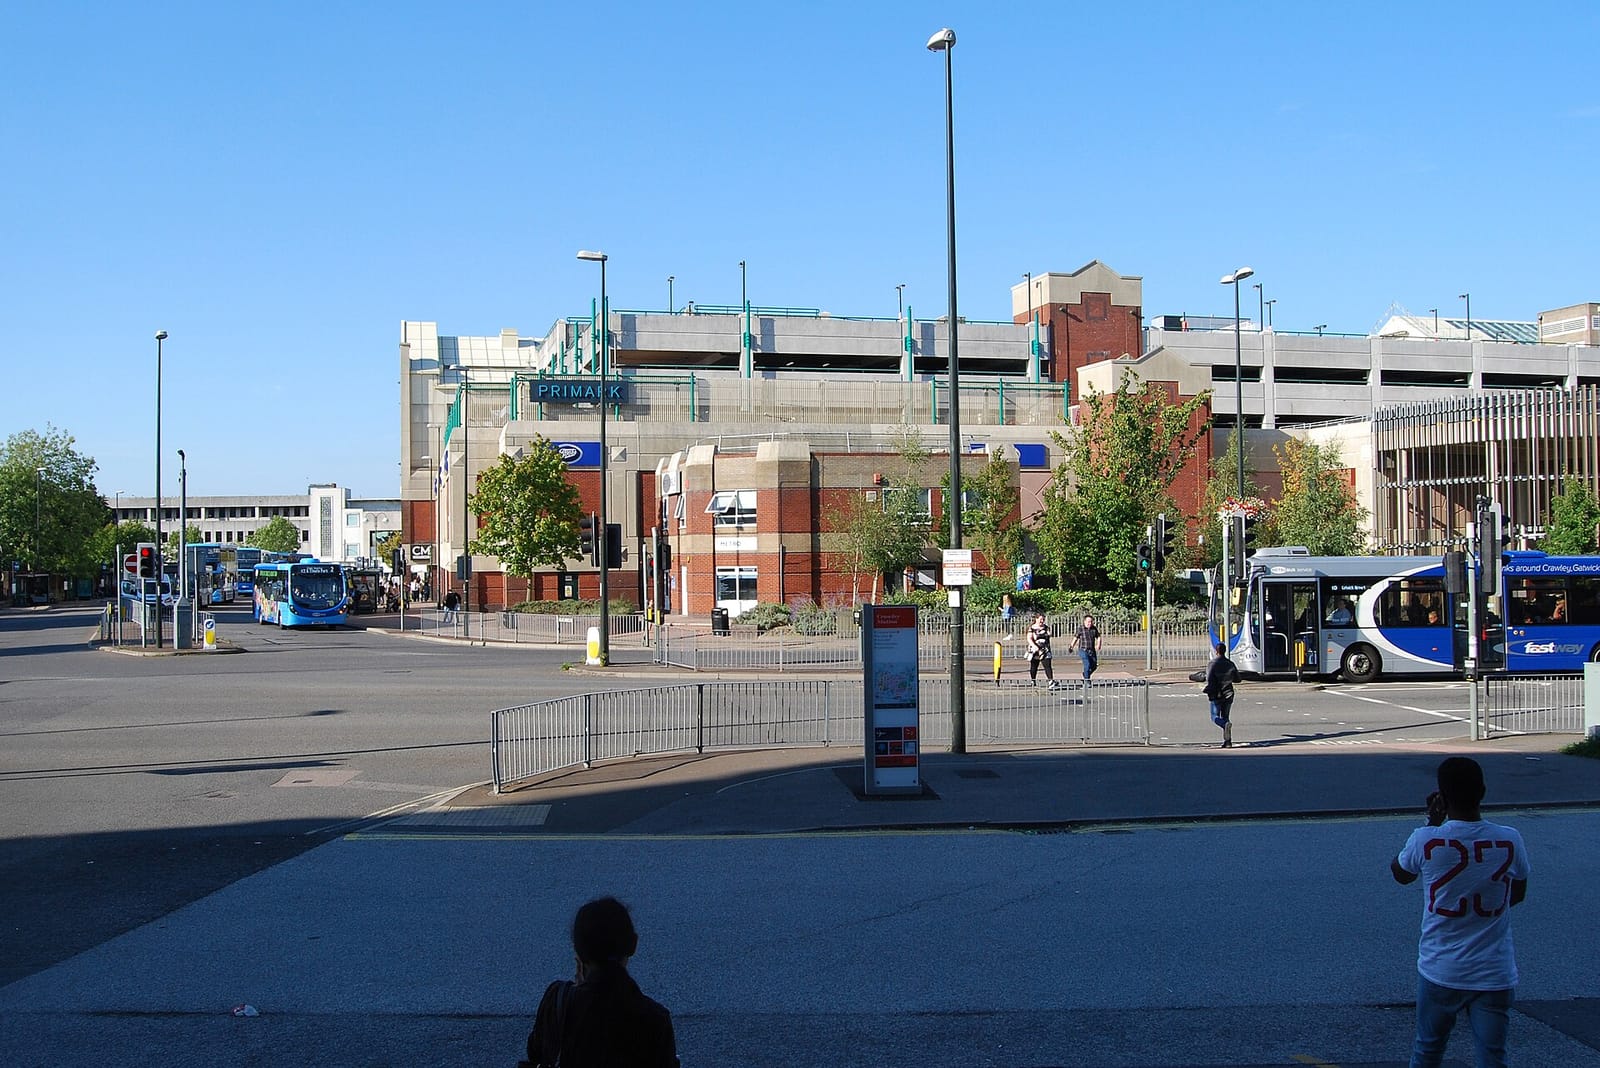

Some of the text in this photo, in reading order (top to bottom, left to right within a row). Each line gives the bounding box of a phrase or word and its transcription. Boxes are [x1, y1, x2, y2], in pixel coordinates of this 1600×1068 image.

[538, 384, 620, 398] PRIMARK
[1515, 564, 1541, 572] around
[1524, 641, 1585, 654] fastway
[1424, 838, 1514, 918] 23
